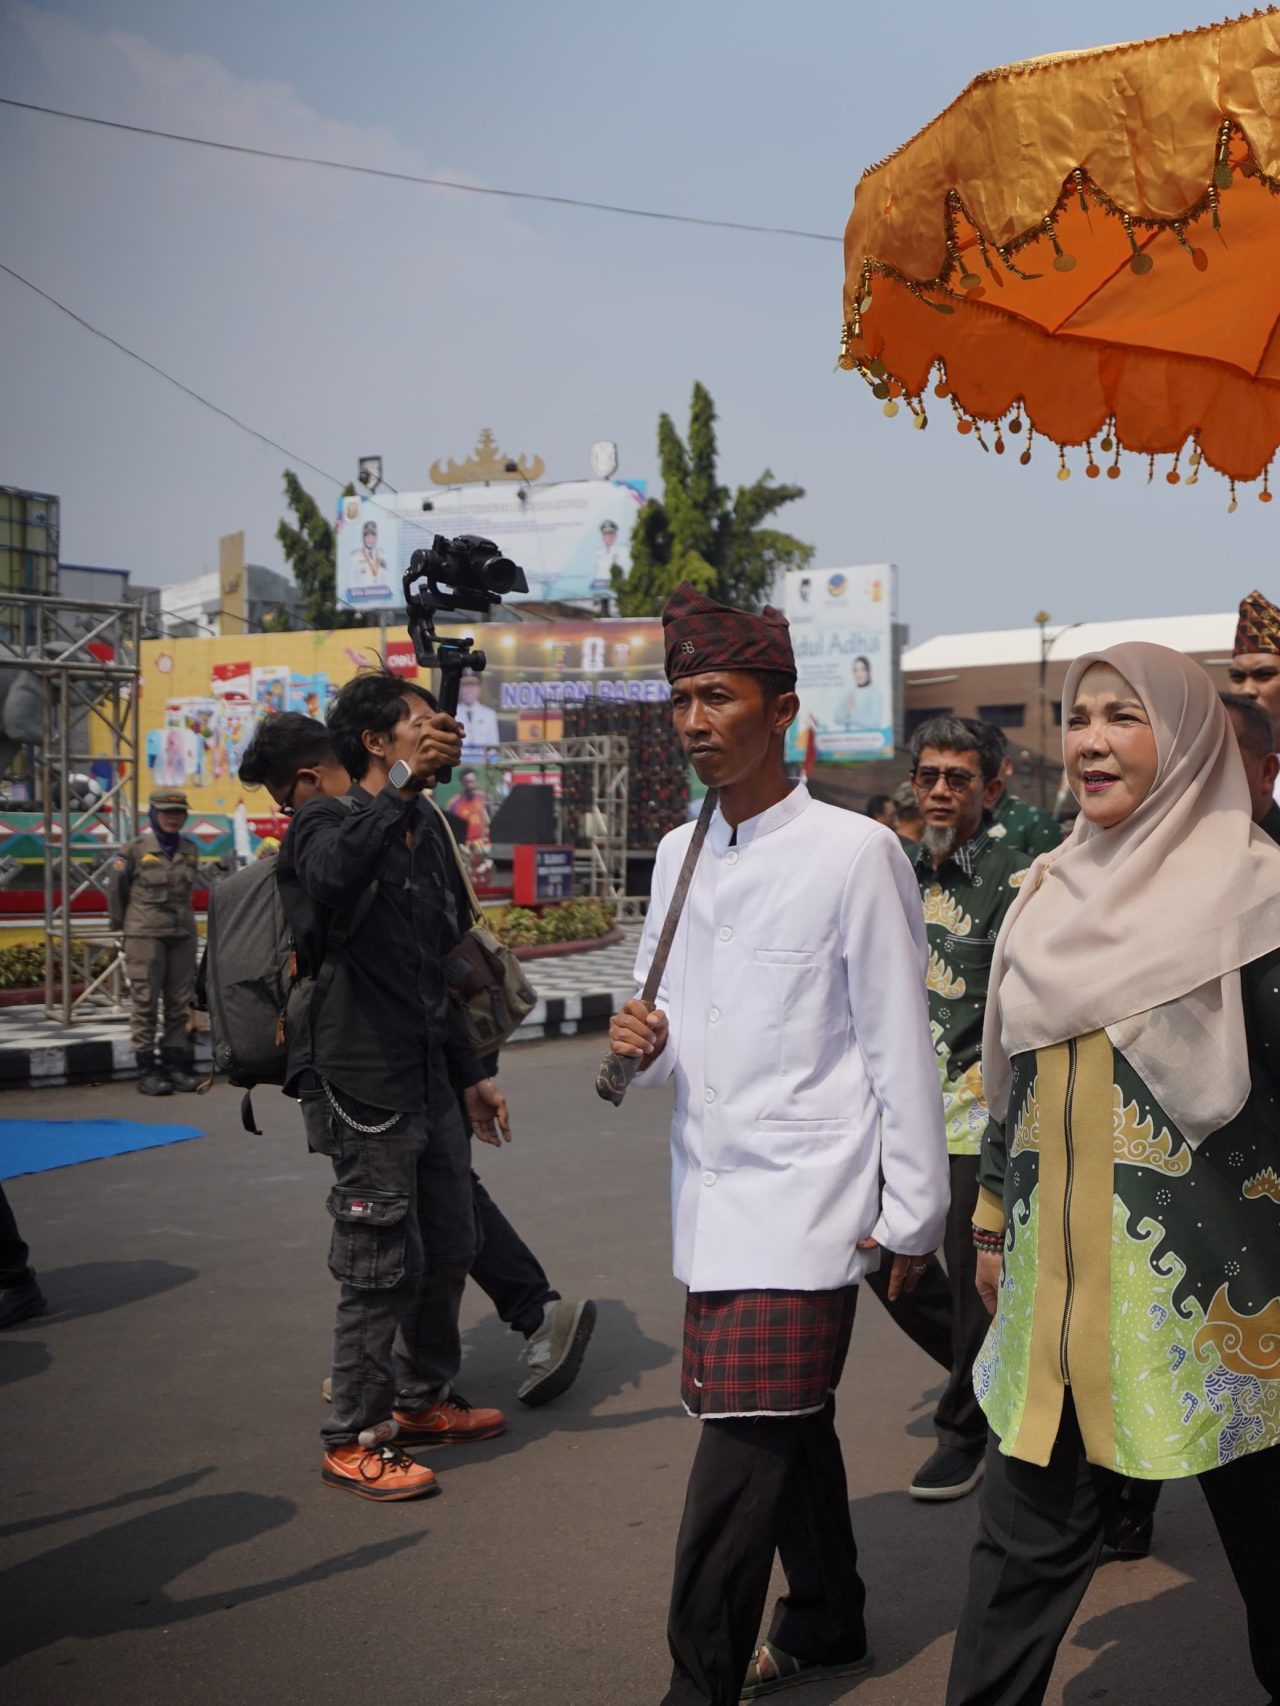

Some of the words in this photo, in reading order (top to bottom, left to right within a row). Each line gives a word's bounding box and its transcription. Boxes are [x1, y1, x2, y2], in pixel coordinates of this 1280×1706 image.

[387, 653, 417, 668] deli
[501, 680, 593, 709] NONTON
[597, 680, 673, 704] BAREN
